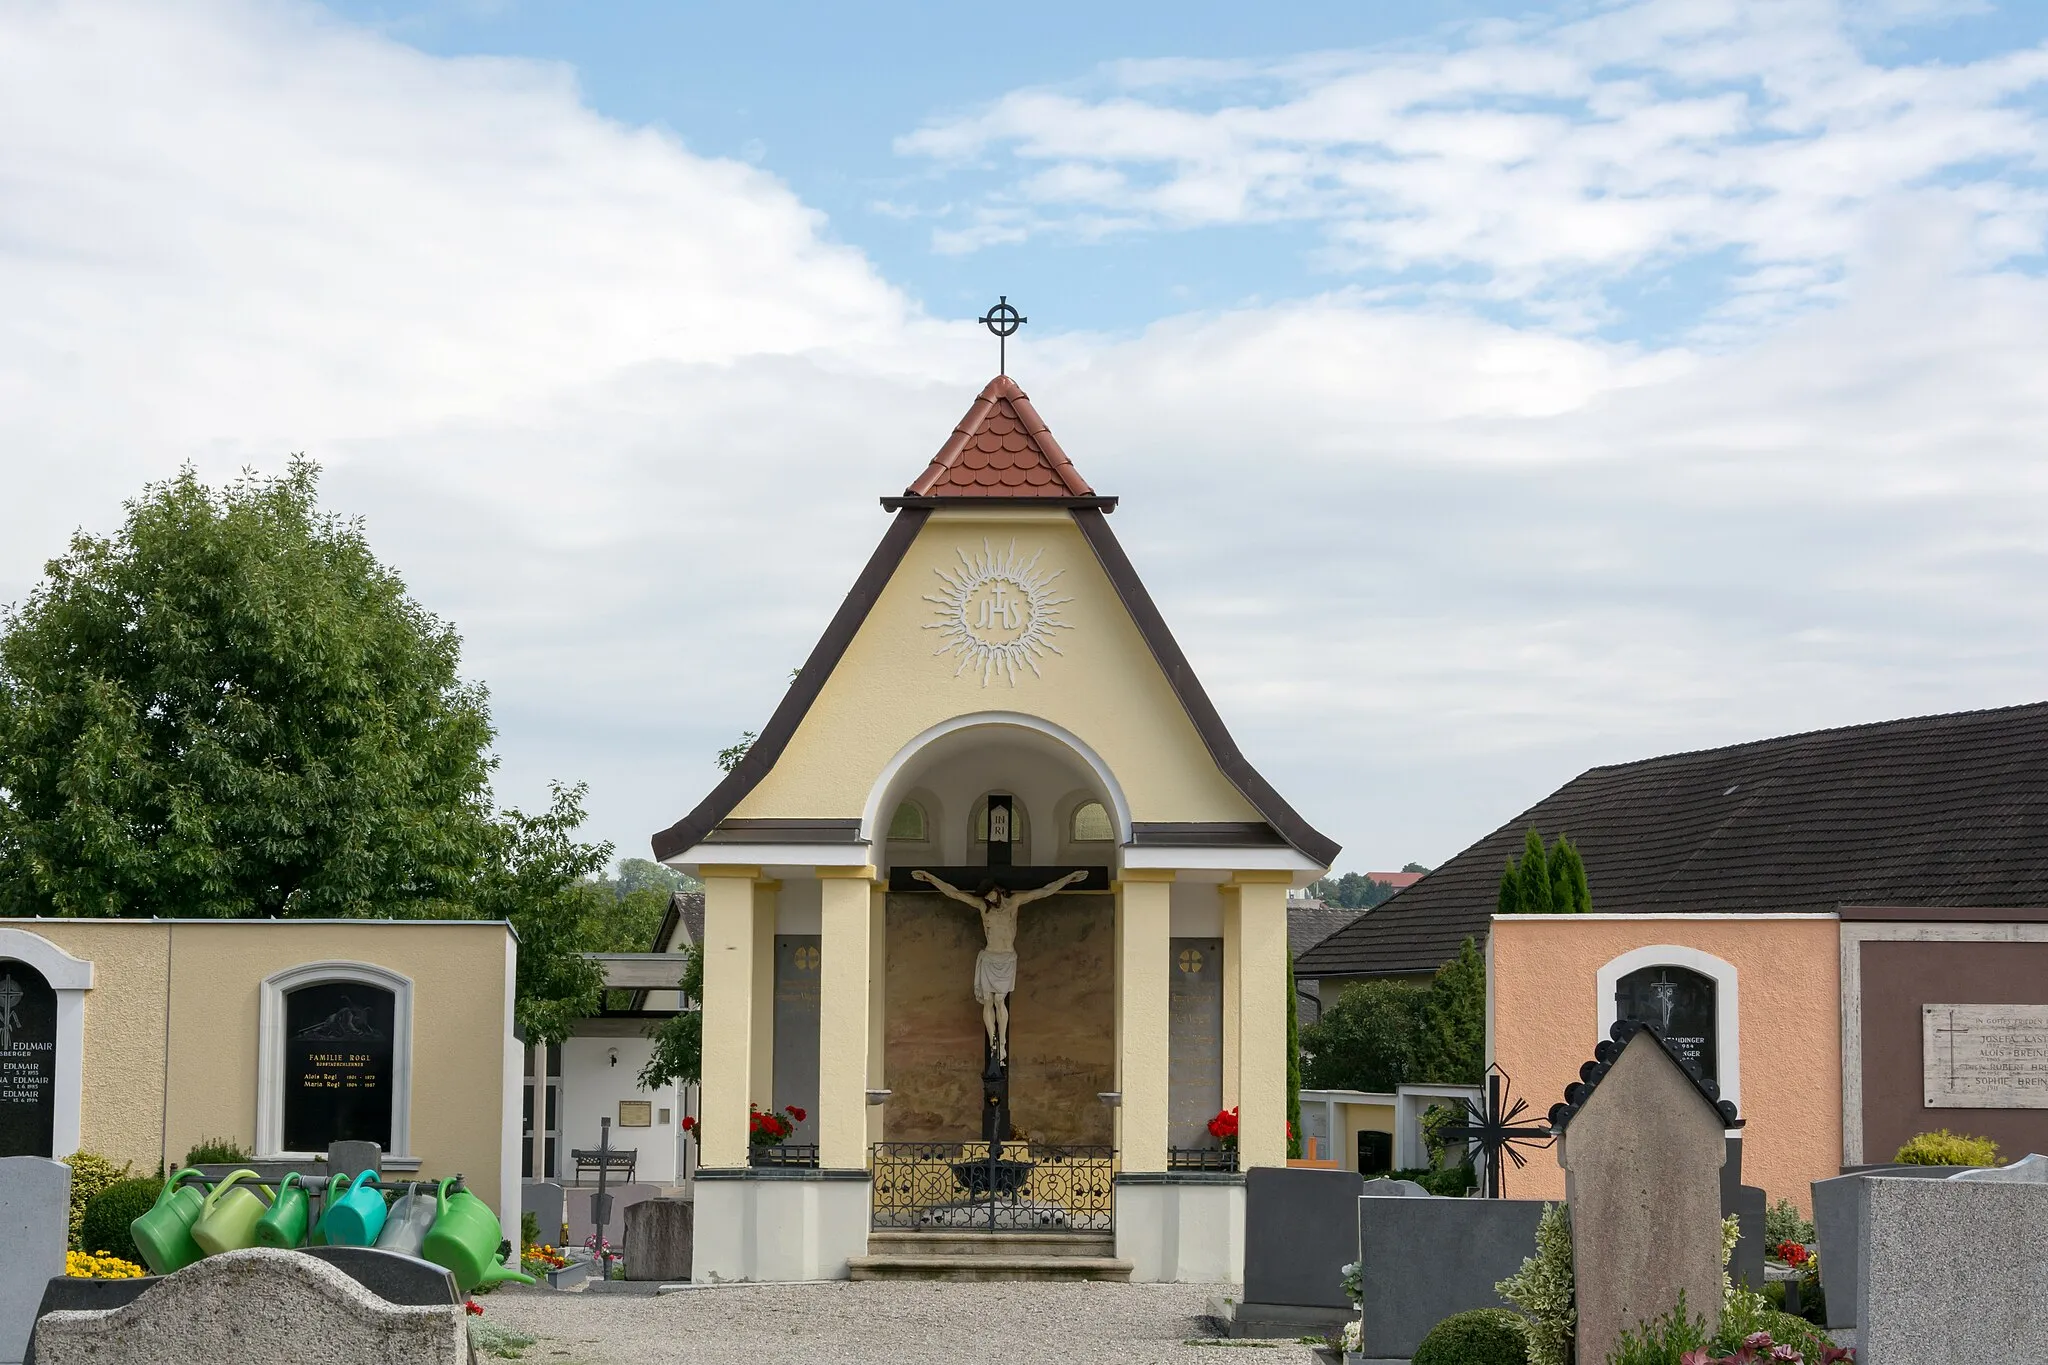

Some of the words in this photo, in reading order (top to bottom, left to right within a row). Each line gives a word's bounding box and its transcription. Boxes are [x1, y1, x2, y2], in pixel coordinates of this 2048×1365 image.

[995, 815, 1005, 824] IN
[995, 826, 1005, 836] RI
[1979, 1035, 2016, 1044] JOSEFA
[13, 1042, 53, 1051] EDLMAIR
[1980, 1049, 2005, 1057] ALOIS
[3, 1062, 39, 1070] EDLMAIR
[1990, 1063, 2025, 1071] ROBERT
[13, 1076, 49, 1084] EDLMAIR
[323, 1073, 337, 1081] Rogl
[1975, 1076, 2009, 1086] SOPHIE
[326, 1081, 340, 1089] Rogl
[3, 1090, 39, 1098] EDLMAIR
